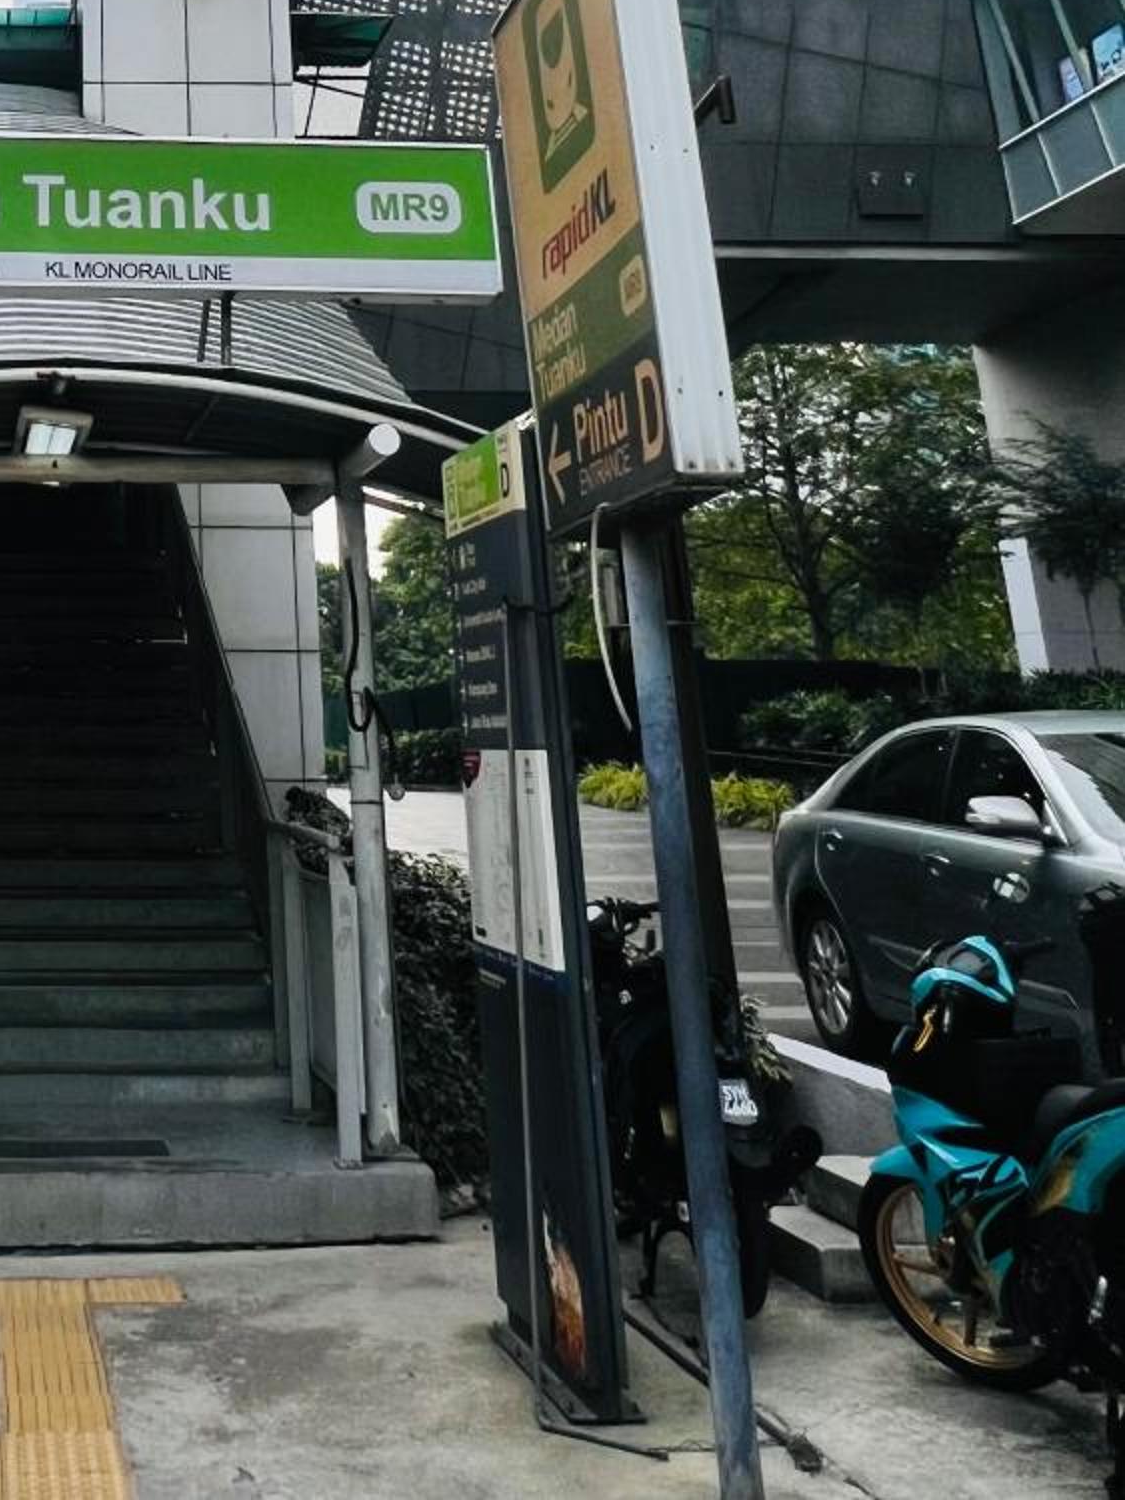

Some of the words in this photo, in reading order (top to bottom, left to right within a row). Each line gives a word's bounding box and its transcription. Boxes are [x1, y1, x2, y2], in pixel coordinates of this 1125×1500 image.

[22, 173, 271, 231] Tuanku
[369, 192, 450, 222] MR9
[542, 166, 616, 280] rapidKL
[45, 261, 72, 278] KL
[74, 262, 184, 280] MONORAIL
[187, 263, 232, 281] LINE
[531, 303, 579, 363] Medan
[573, 388, 629, 464] Pintu
[635, 358, 664, 466] D
[579, 441, 634, 497] ENTRANCE
